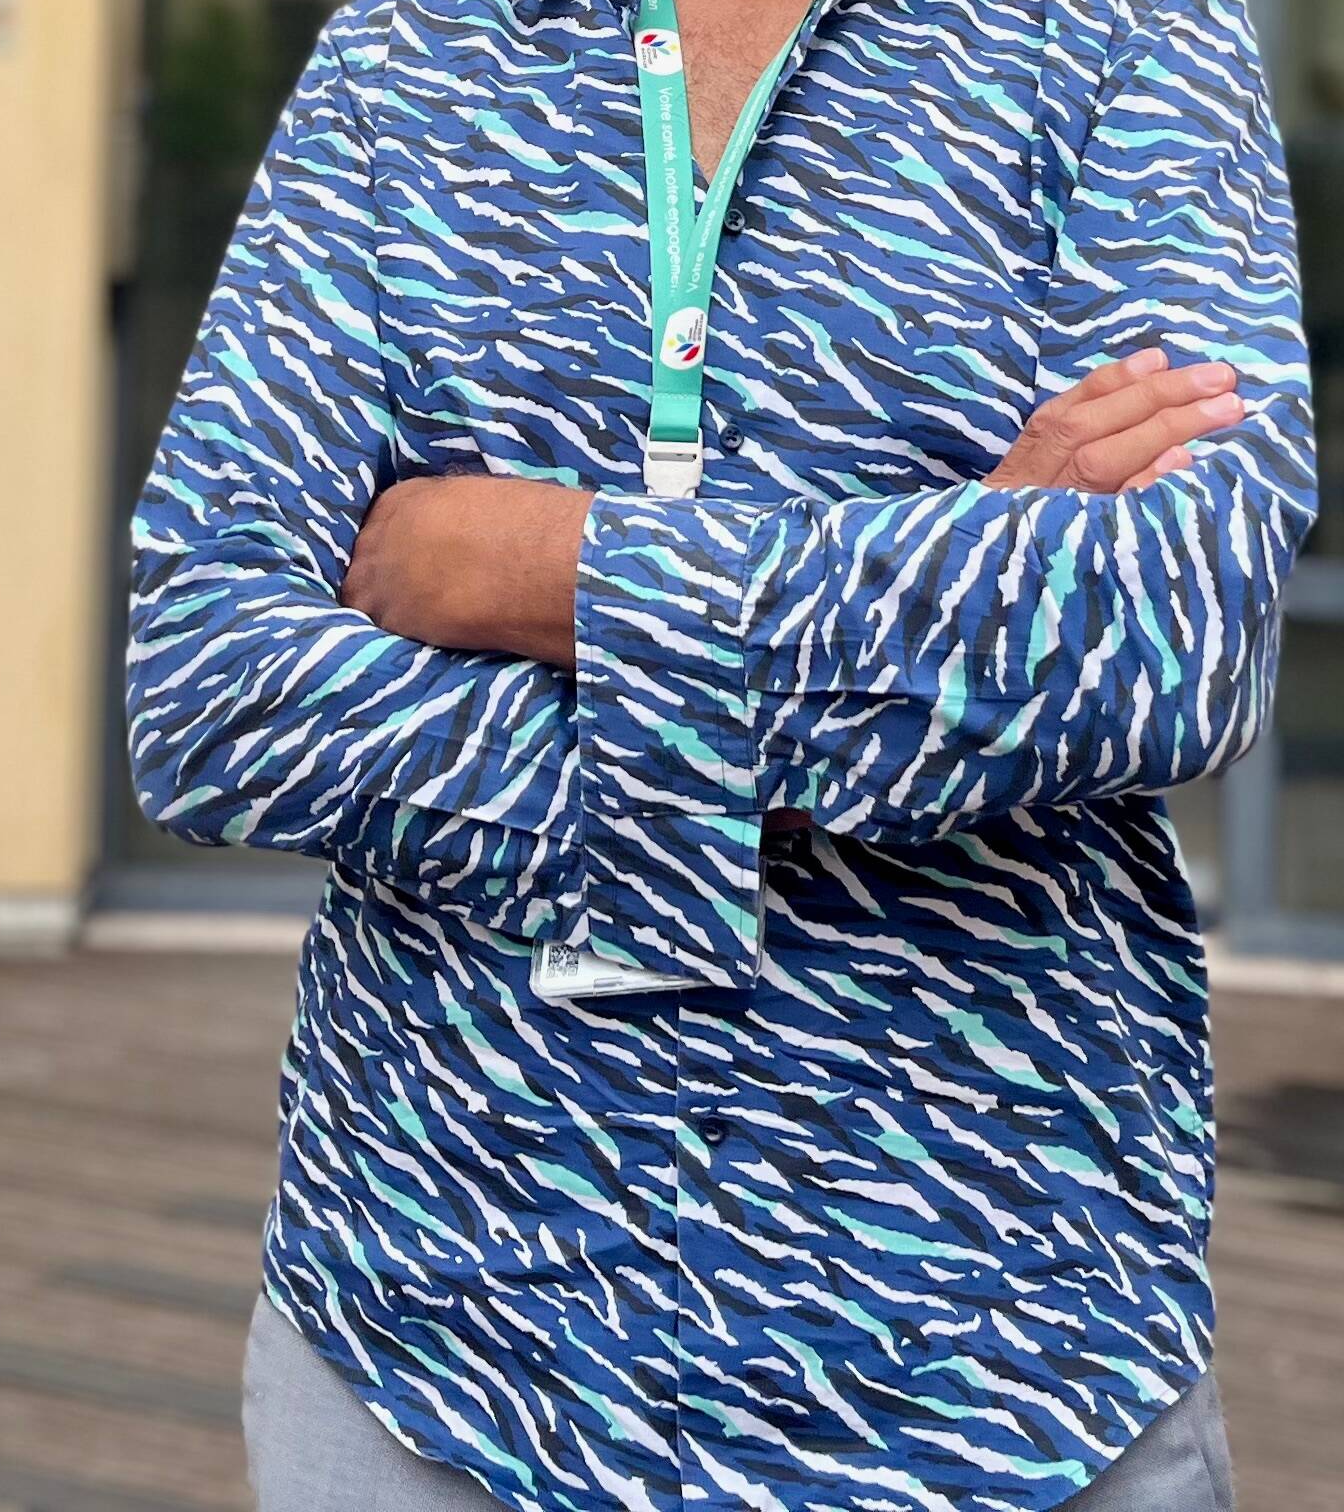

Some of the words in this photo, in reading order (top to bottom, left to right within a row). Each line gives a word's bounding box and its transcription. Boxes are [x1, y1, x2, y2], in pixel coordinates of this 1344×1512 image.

[659, 86, 673, 123] Votre
[661, 123, 676, 164] santé,
[664, 167, 677, 203] notre
[688, 252, 705, 292] Votre
